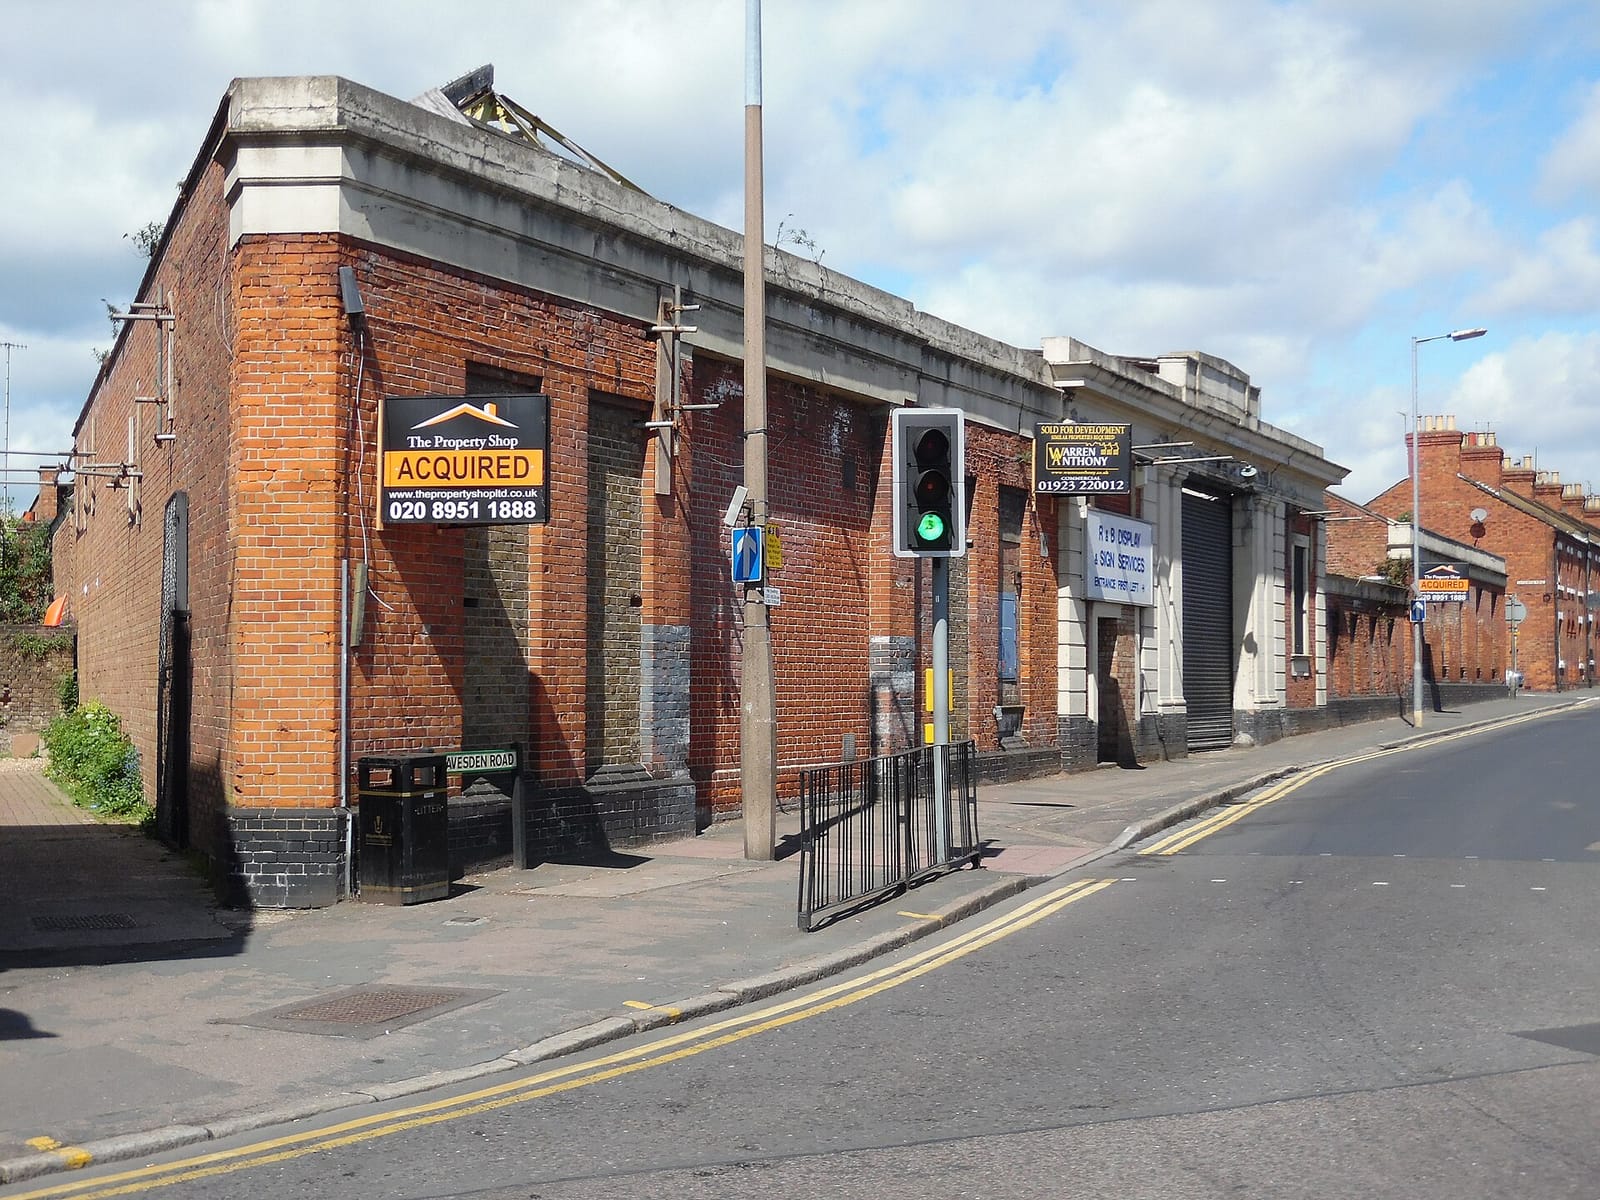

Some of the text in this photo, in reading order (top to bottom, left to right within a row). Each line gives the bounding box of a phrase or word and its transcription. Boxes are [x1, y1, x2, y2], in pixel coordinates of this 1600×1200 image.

[1041, 426, 1125, 434] SOLD FOR DEVELOPMENT
[406, 434, 519, 450] The Property Shop
[1048, 447, 1096, 459] WARREN
[1052, 456, 1108, 466] ANTHONY
[397, 455, 530, 481] ACQUIRED
[1038, 480, 1124, 491] 01923 220012
[388, 489, 538, 500] www.thepropertyshopltd.co.uk
[389, 500, 537, 519] 020 8951 1888
[1098, 525, 1104, 541] R
[1110, 527, 1116, 543] B
[1117, 528, 1141, 548] DISPLAY
[1099, 550, 1115, 568] SIGN
[1117, 553, 1145, 573] SERVICES
[1421, 581, 1464, 589] ACQUIRED
[489, 753, 514, 767] ROAD
